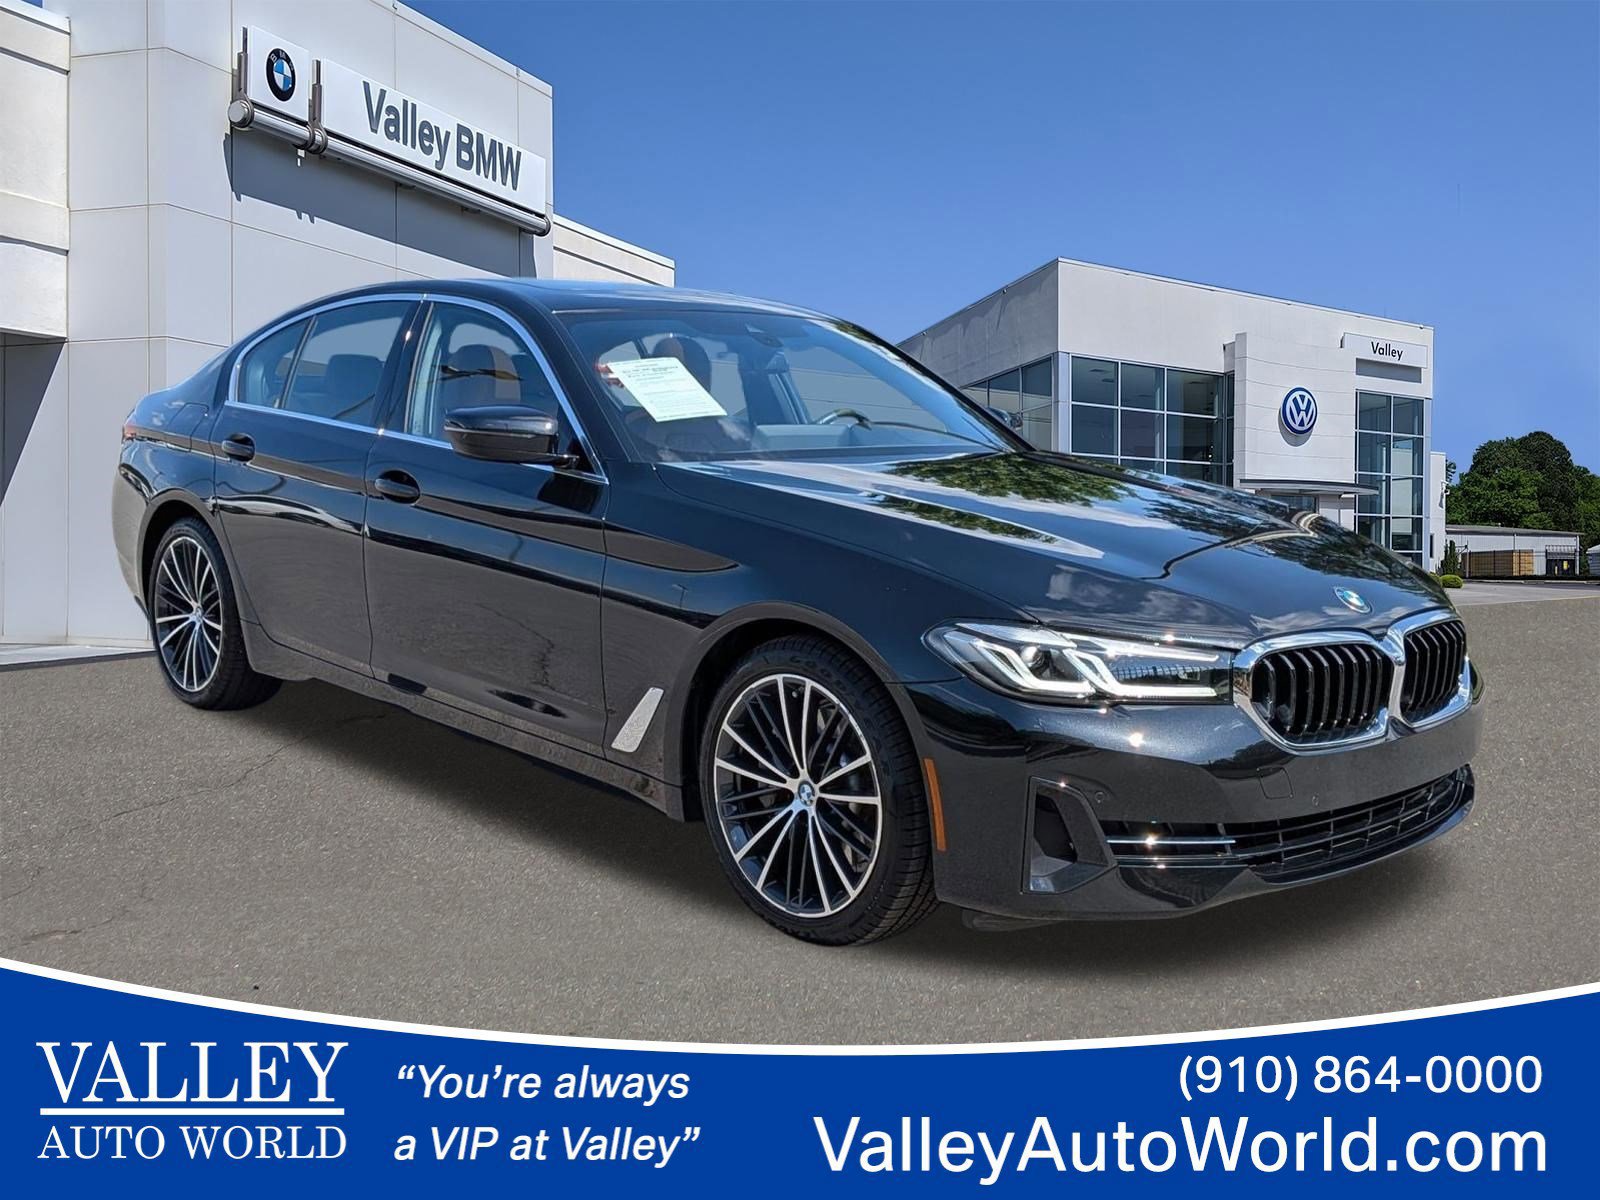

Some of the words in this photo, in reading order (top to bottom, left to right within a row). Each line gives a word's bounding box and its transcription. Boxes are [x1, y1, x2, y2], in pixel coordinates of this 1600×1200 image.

[362, 81, 450, 170] Valley
[456, 123, 522, 191] BMW
[1371, 341, 1403, 361] Valley
